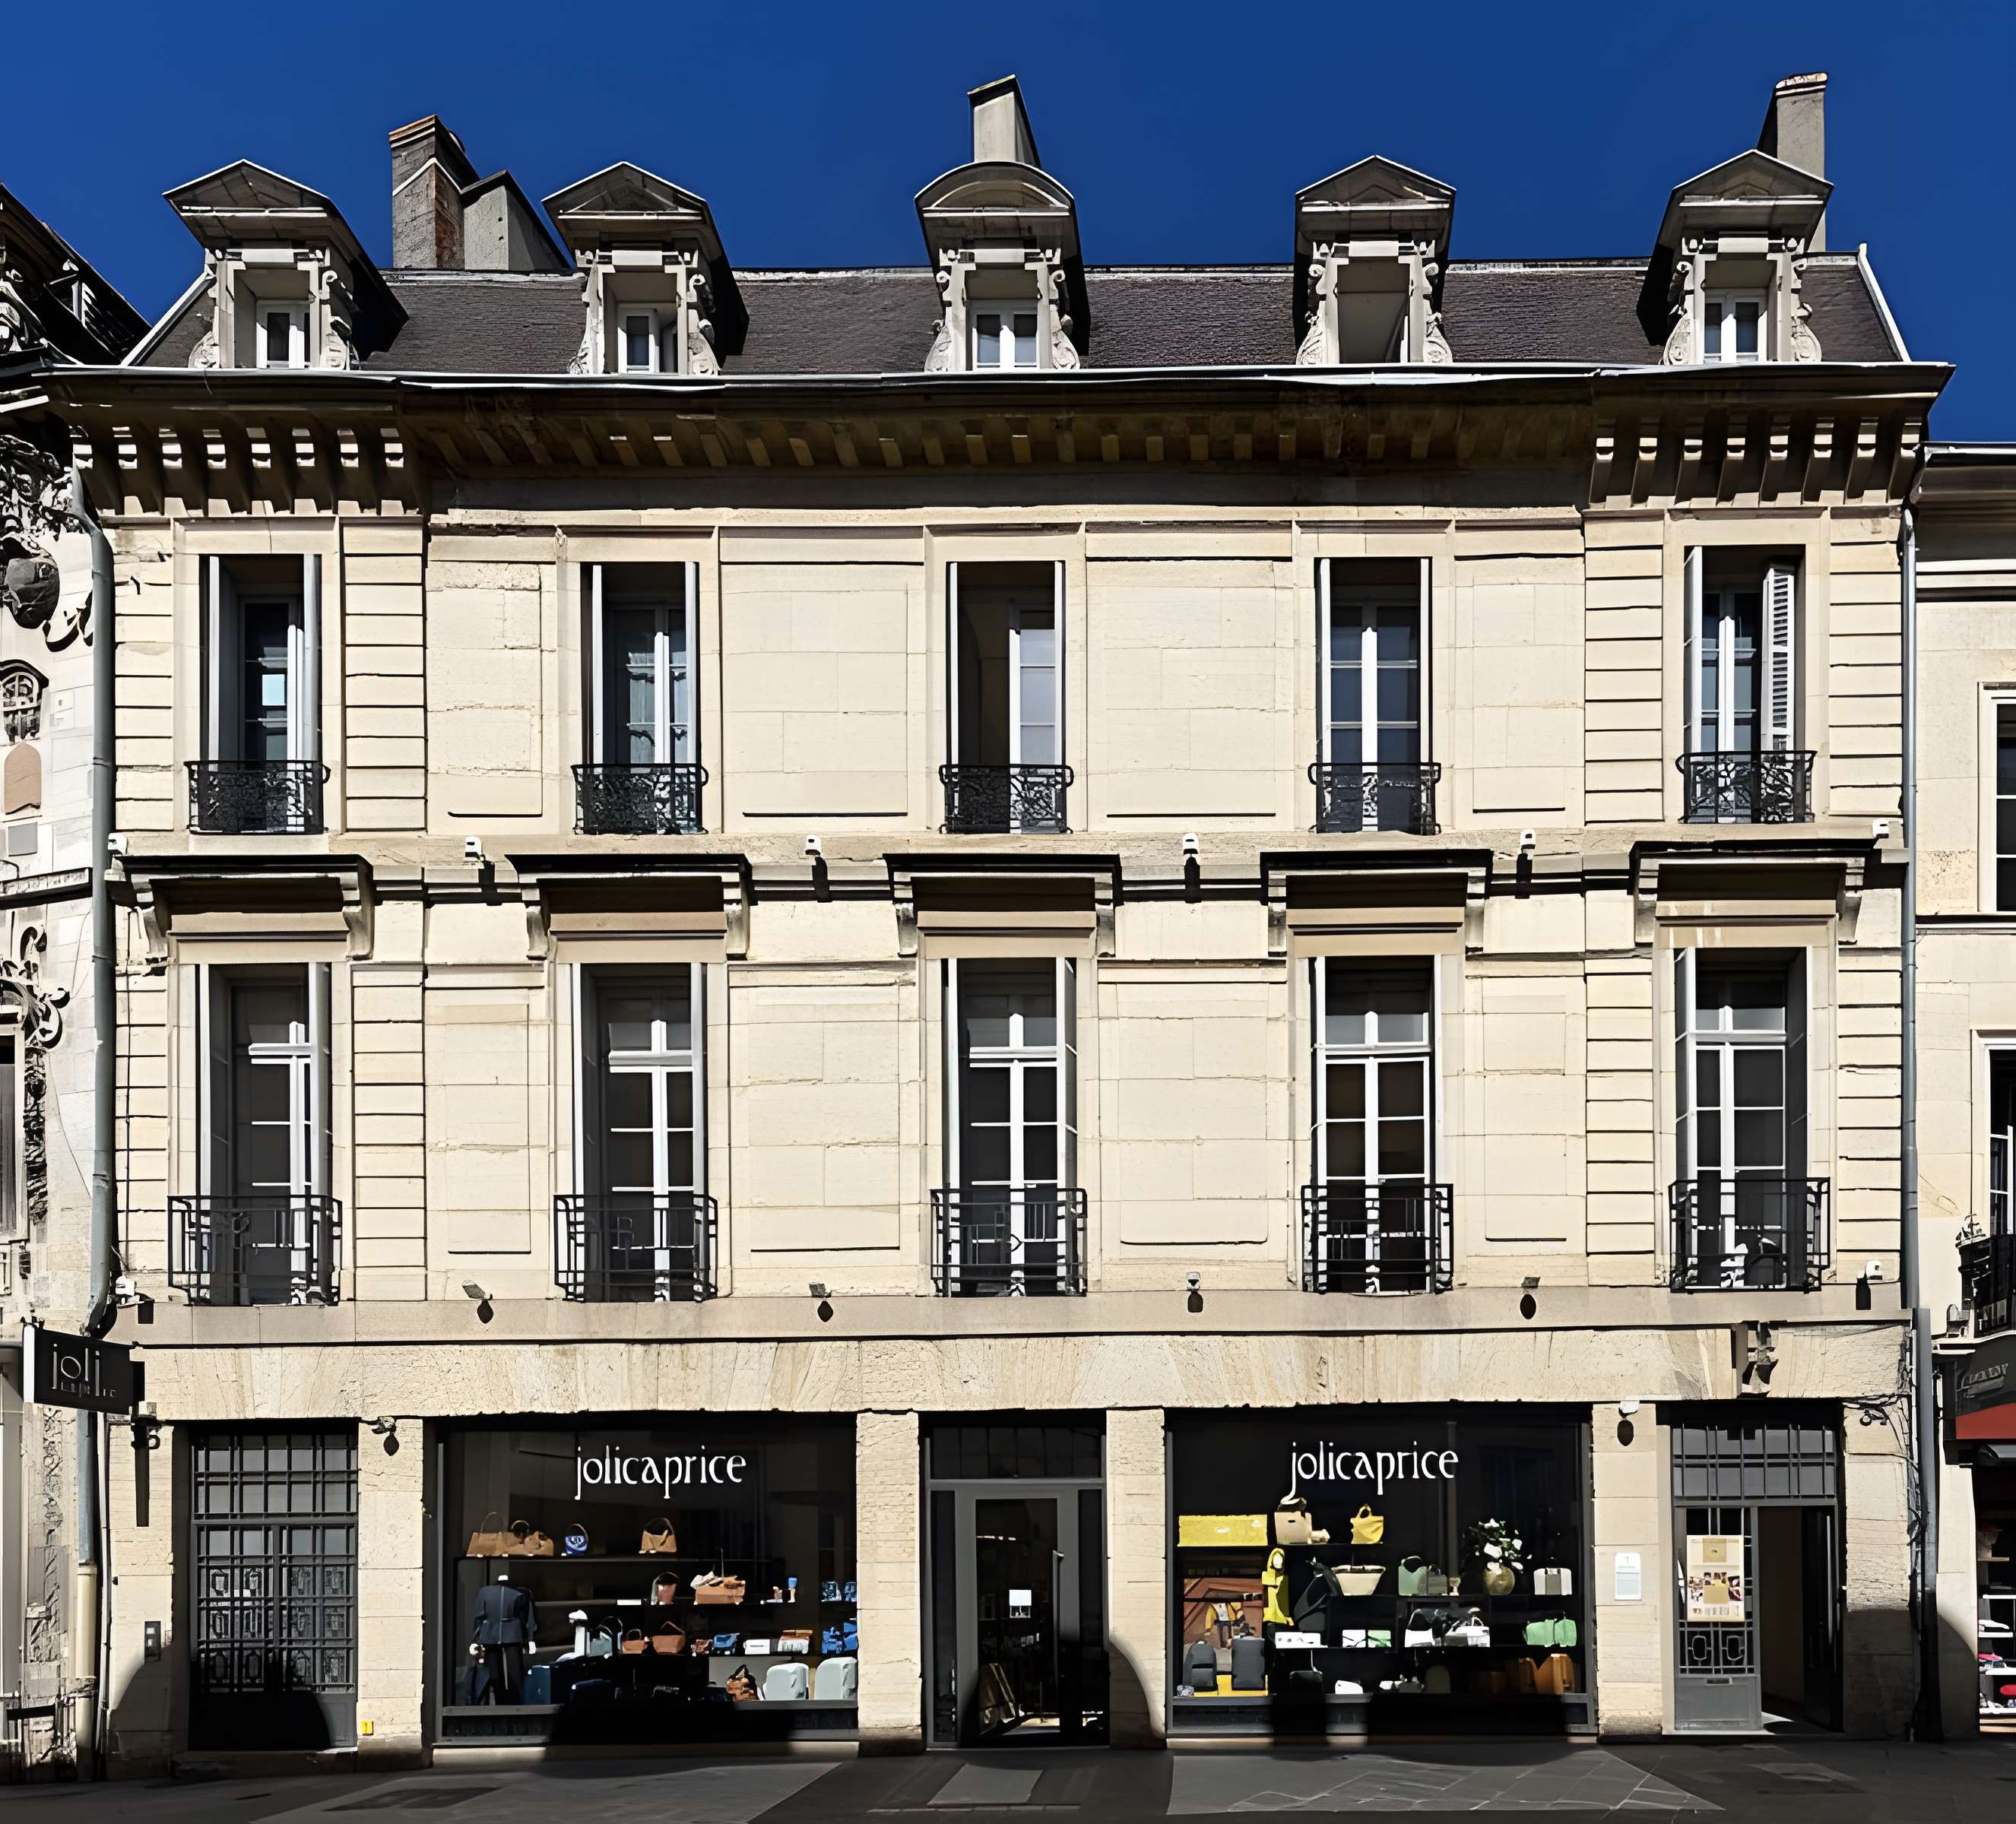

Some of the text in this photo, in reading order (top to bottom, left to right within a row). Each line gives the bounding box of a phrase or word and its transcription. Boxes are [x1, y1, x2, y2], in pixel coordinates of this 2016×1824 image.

[50, 1343, 100, 1397] joli
[575, 1445, 746, 1500] jolicaprice
[1282, 1441, 1459, 1503] jolicaprice
